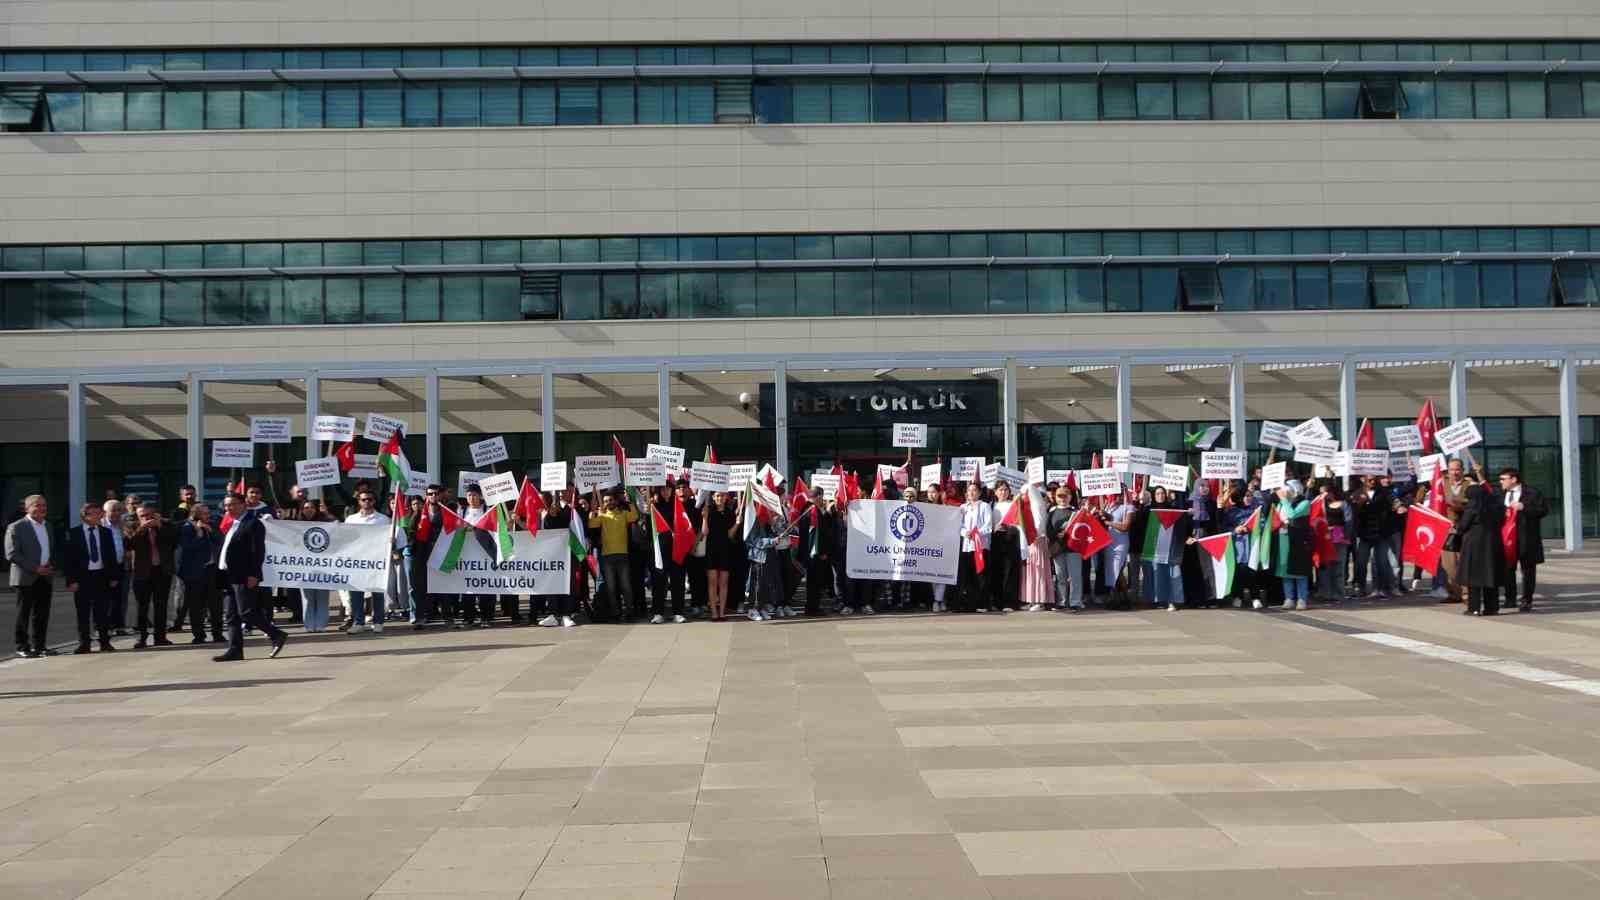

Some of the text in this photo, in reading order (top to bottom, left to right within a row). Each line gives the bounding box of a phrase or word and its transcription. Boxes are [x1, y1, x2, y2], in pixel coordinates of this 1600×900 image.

[650, 448, 681, 457] ÇOCUKLAR
[335, 557, 386, 570] ÖĞRENCİ
[892, 558, 918, 567] TMER
[278, 571, 350, 584] TOPLULUĞU
[464, 576, 535, 588] TOPLULUĞU
